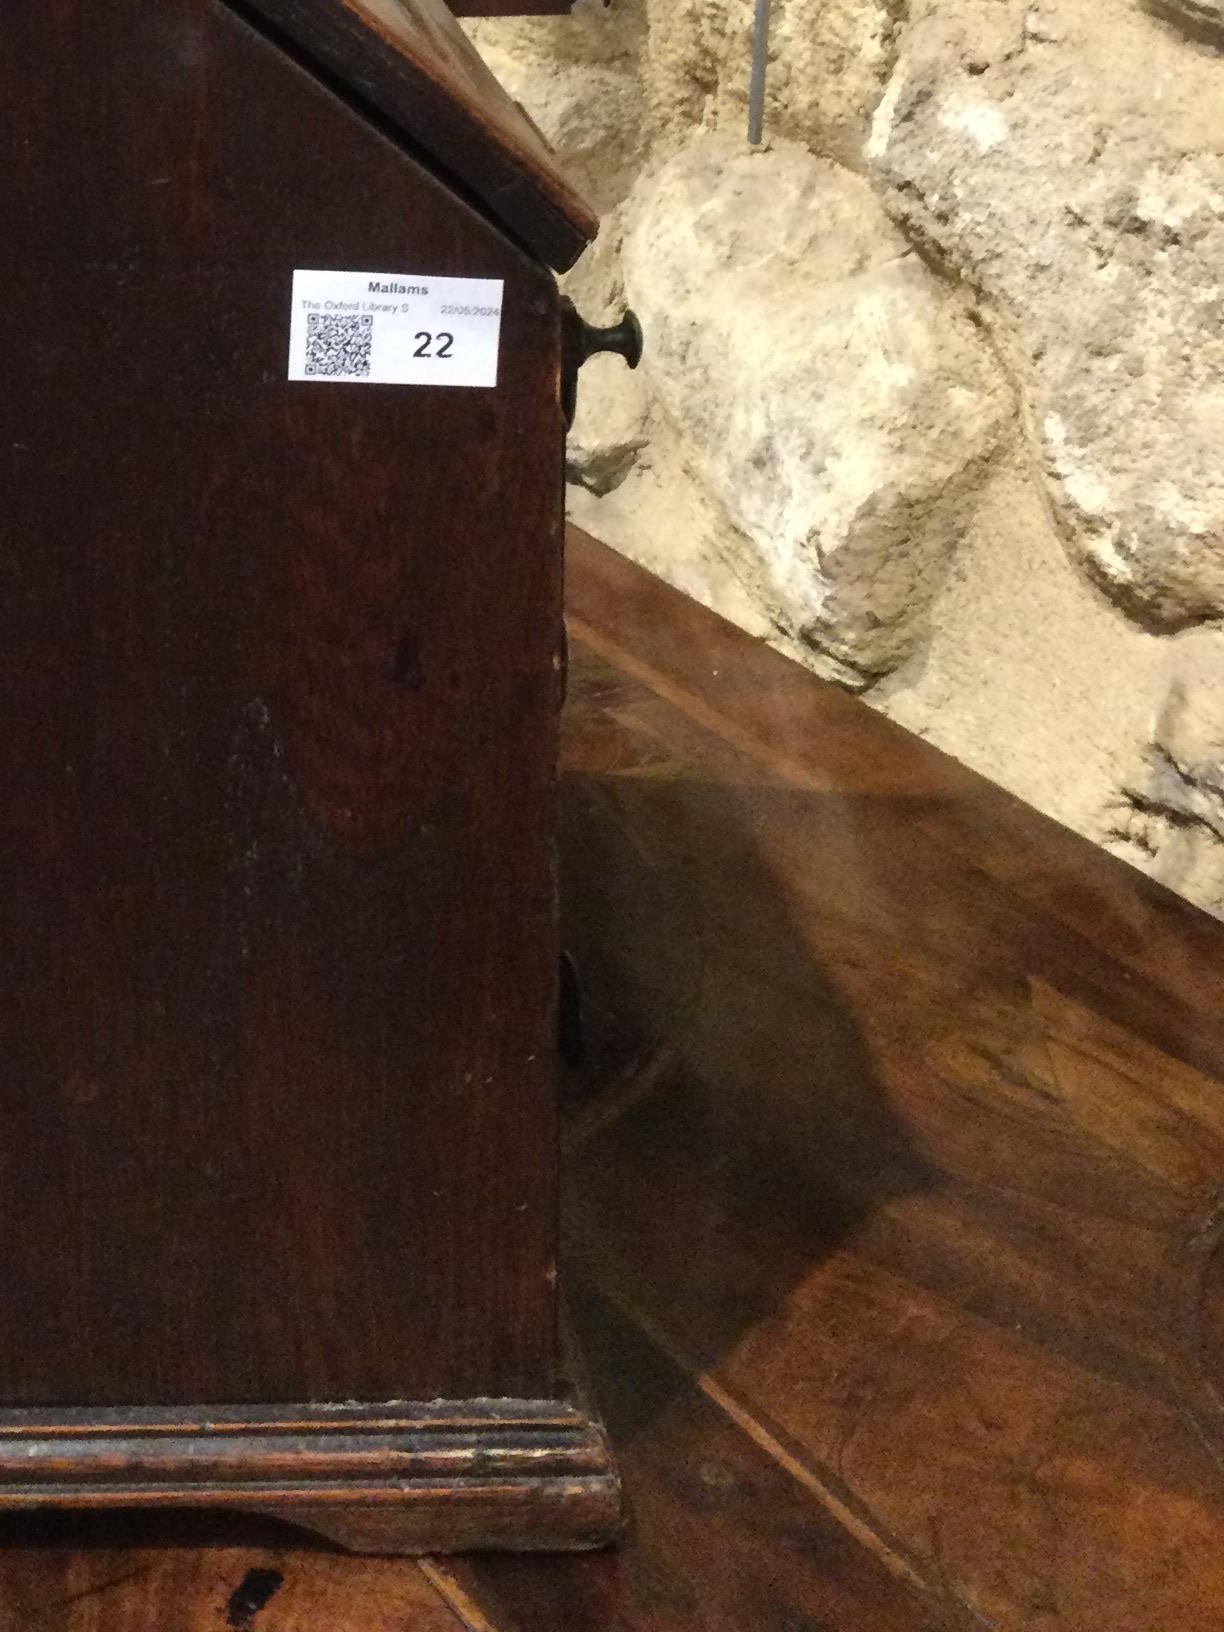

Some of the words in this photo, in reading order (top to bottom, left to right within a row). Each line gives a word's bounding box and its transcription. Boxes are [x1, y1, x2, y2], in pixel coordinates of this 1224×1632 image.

[368, 282, 429, 295] Mallams
[302, 300, 320, 311] The
[324, 301, 359, 311] Oxford
[362, 303, 398, 315] Library
[413, 332, 454, 359] 22
